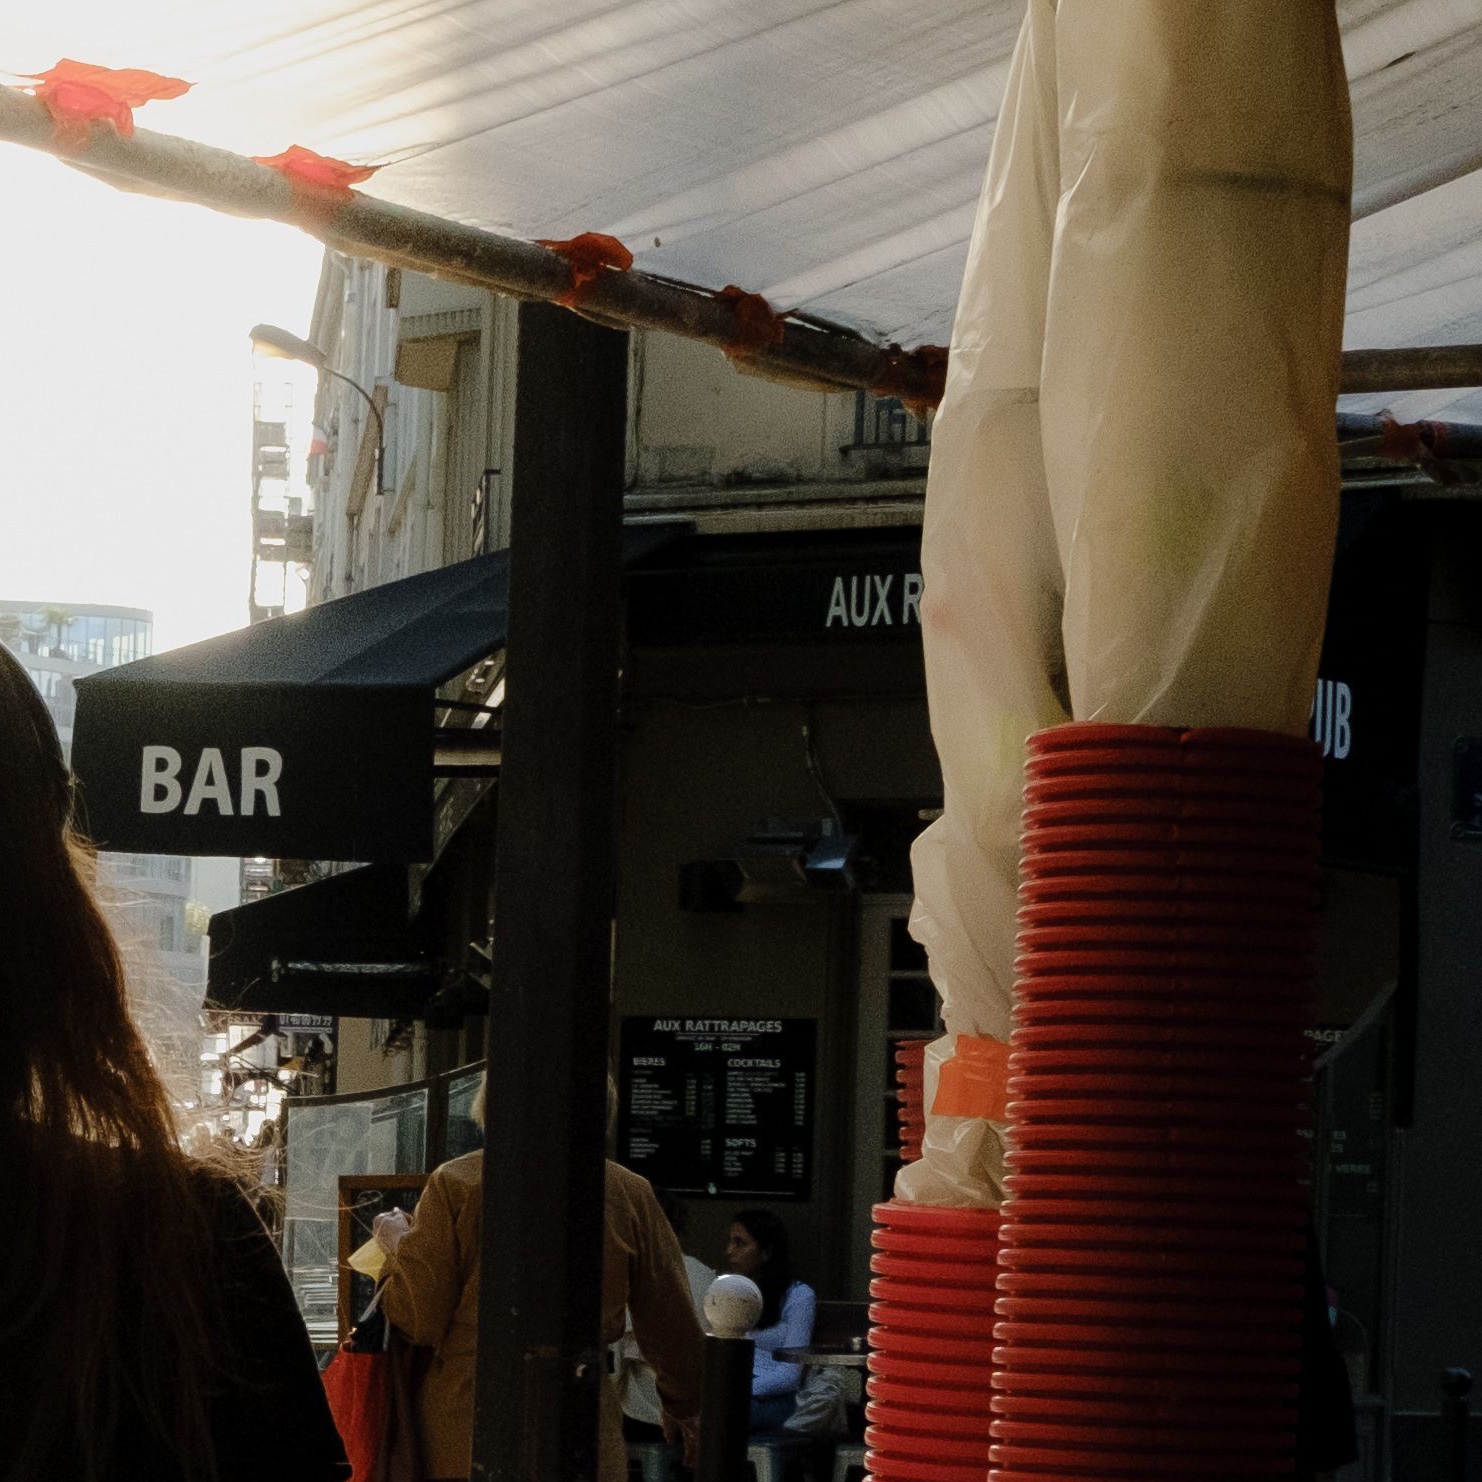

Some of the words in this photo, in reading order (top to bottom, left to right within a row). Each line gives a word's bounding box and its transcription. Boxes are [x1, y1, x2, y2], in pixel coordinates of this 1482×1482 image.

[825, 573, 894, 628] AUX
[901, 572, 925, 625] R
[1309, 676, 1353, 760] UB
[139, 744, 285, 818] BAR
[653, 1019, 681, 1032] AUX
[685, 1019, 783, 1033] RATTRAPAGES
[726, 1058, 782, 1069] COCKTAILS
[725, 1137, 757, 1149] SOFTS
